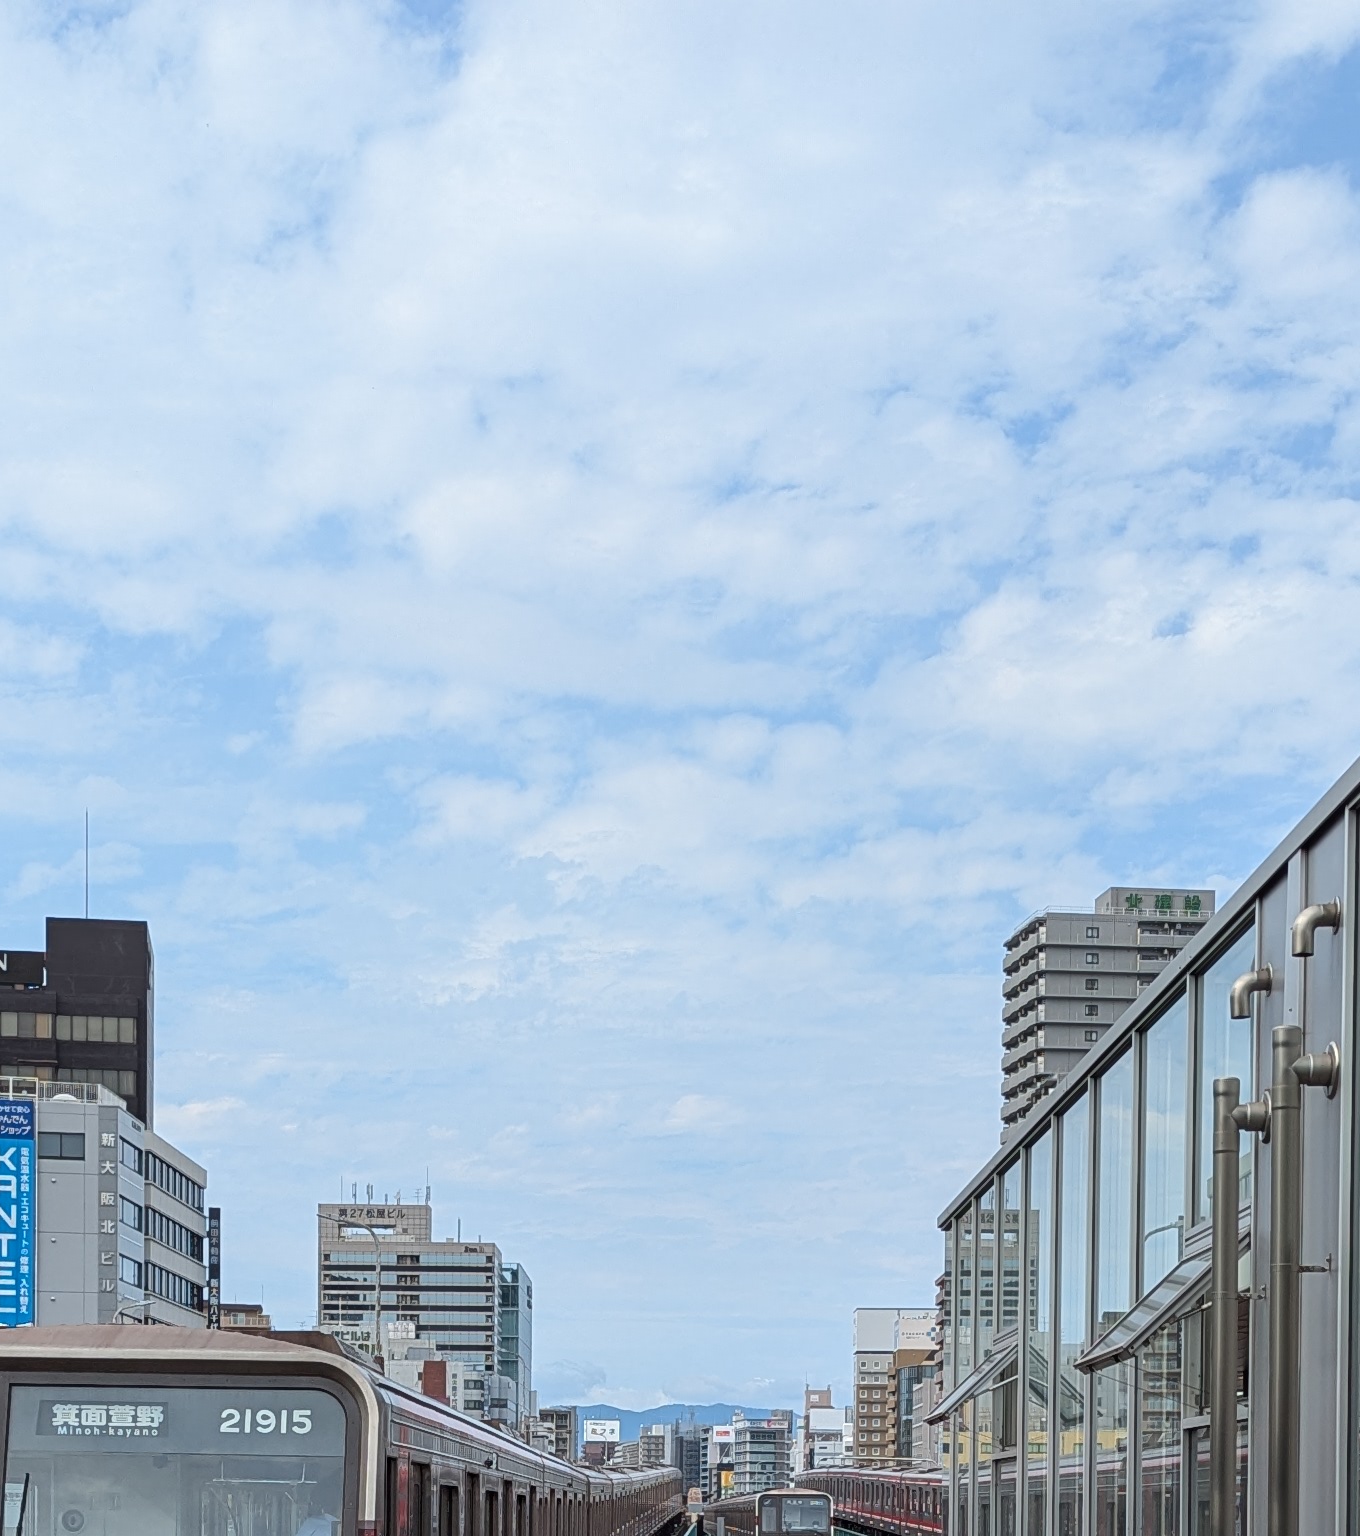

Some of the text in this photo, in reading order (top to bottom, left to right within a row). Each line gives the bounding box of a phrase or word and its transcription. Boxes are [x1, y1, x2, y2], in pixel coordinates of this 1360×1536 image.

[100, 1132, 116, 1293] 新大阪北ビル
[51, 1403, 164, 1428] 箕面萱野
[219, 1408, 313, 1435] 21915
[57, 1426, 159, 1438] Minoh-kayano
